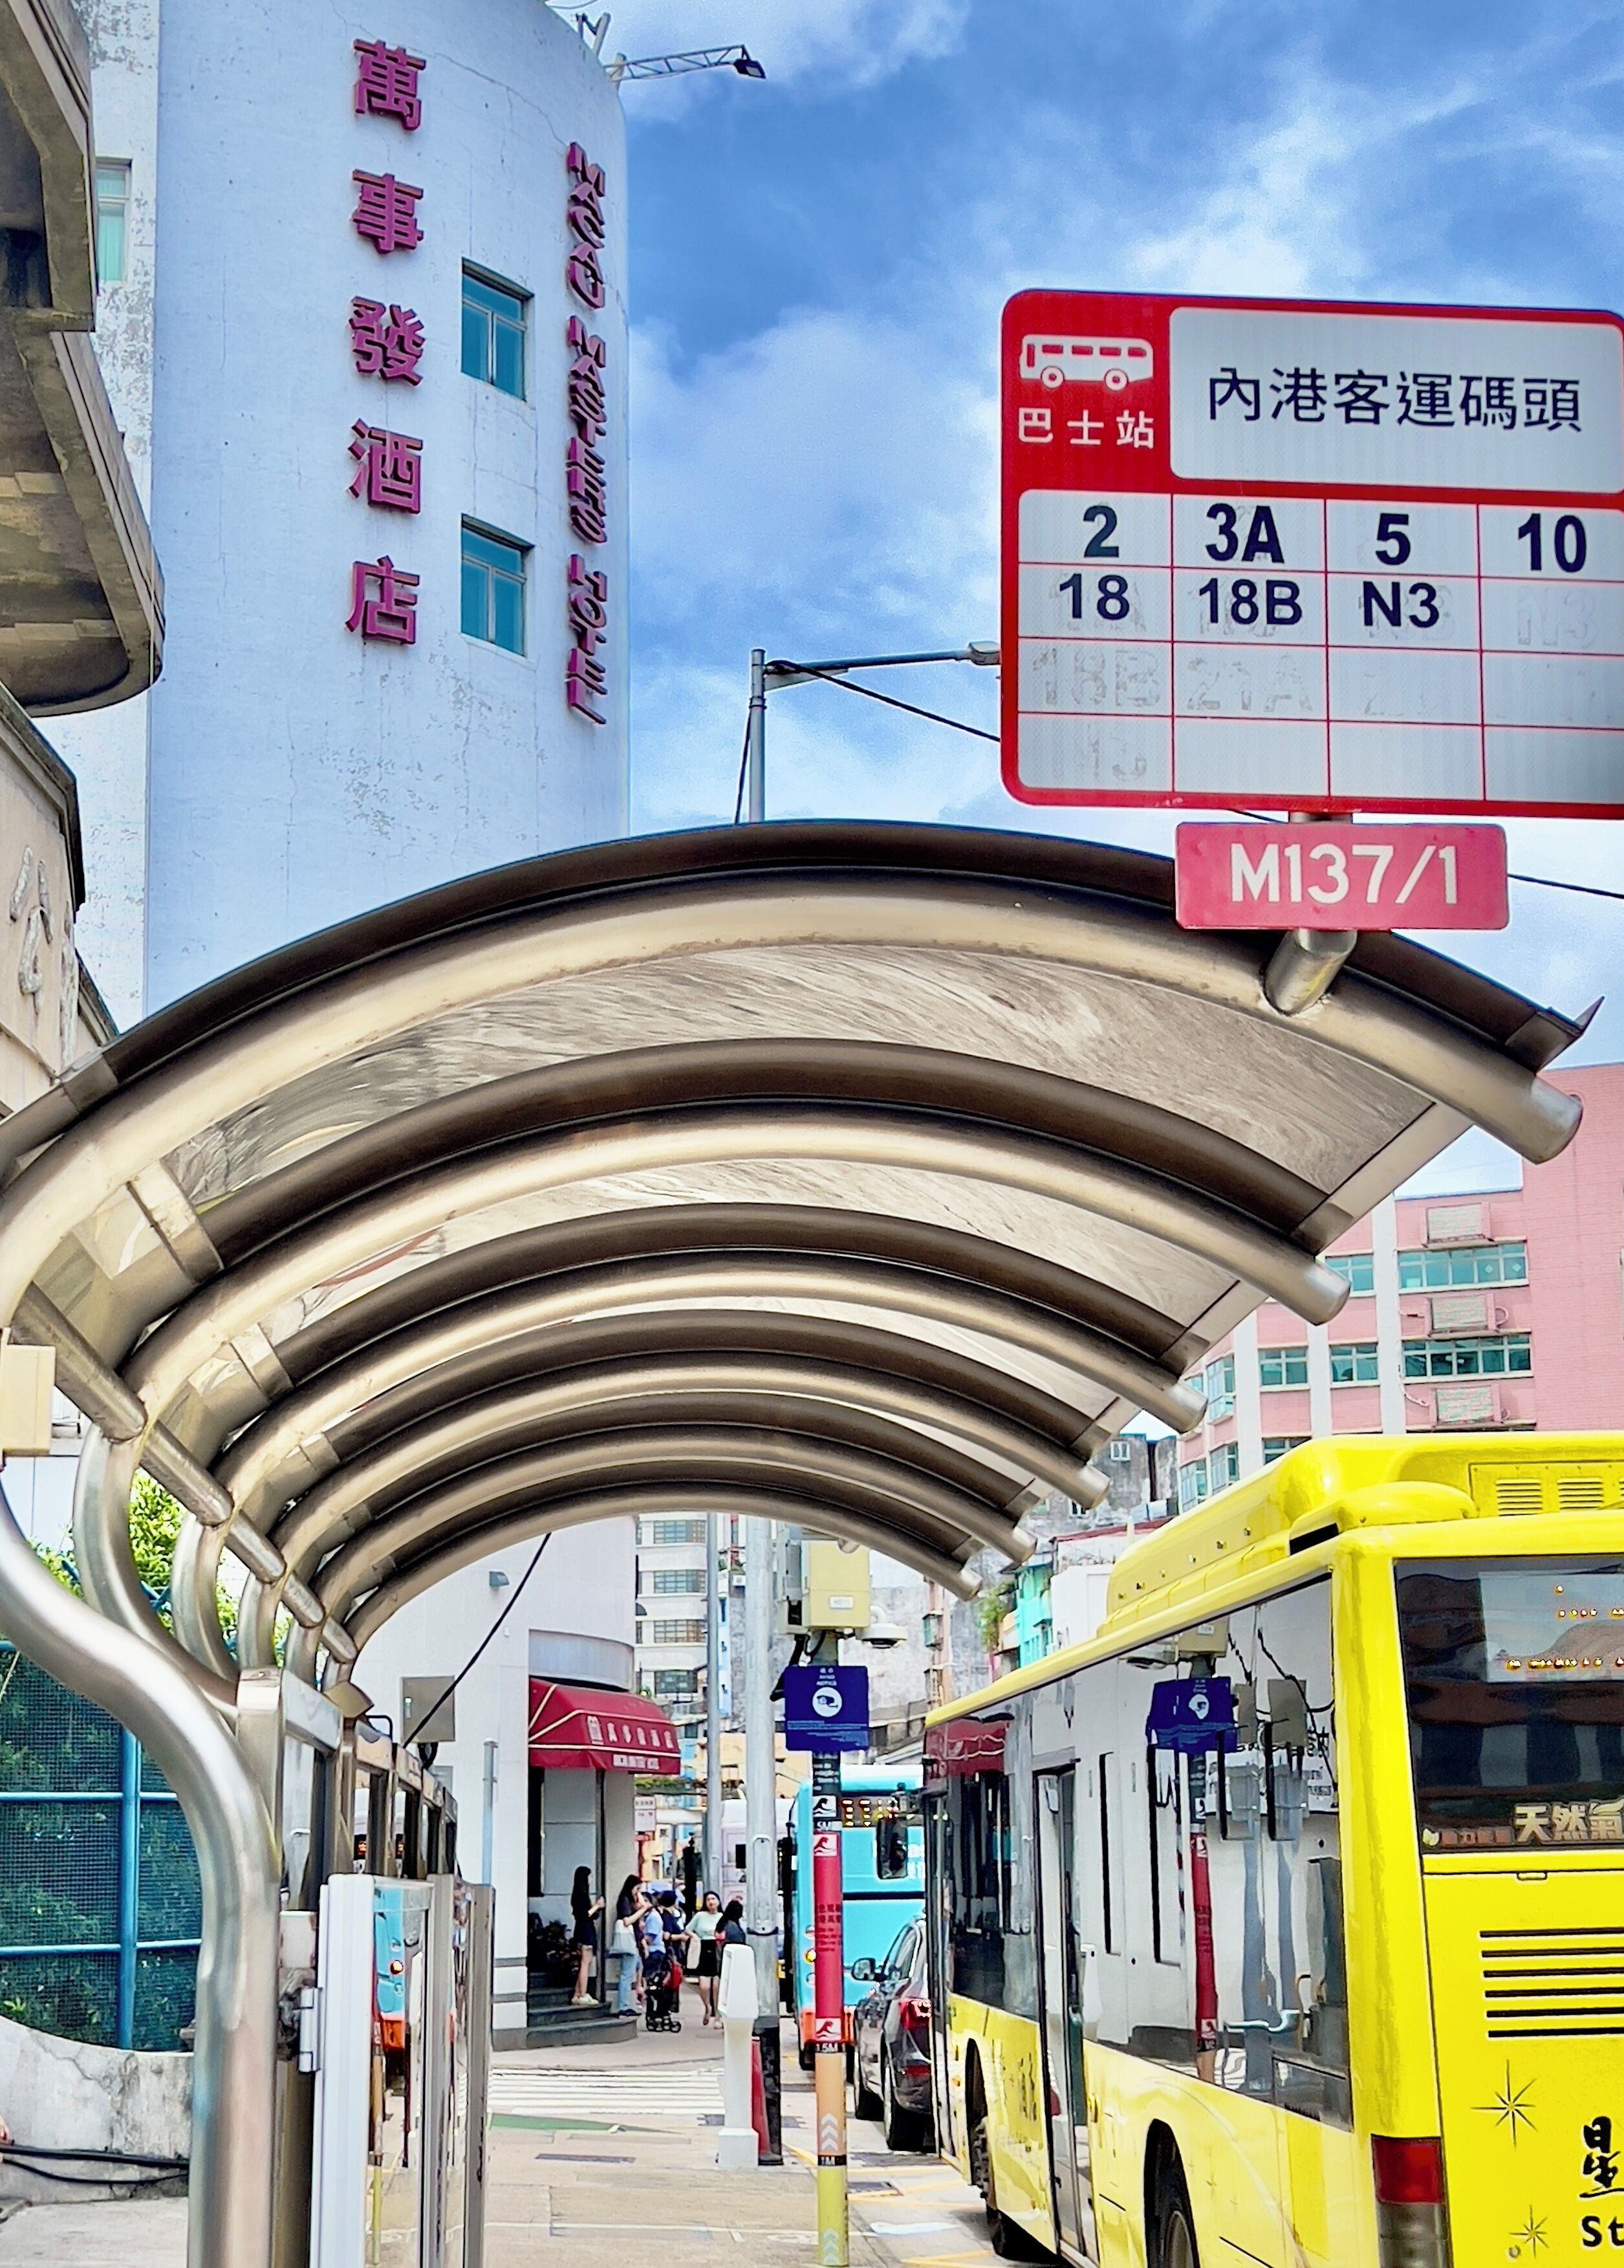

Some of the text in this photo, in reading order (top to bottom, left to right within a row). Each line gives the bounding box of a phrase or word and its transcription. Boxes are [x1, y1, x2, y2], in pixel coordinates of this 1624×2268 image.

[567, 142, 605, 309] MACAU
[346, 39, 425, 646] 萬事發酒店
[1018, 407, 1154, 449] 巴士站
[1209, 367, 1581, 432] 內港客運碼頭
[1083, 503, 1588, 572] 2 3A 5 10
[1059, 573, 1440, 628] 18 18B N3
[566, 554, 607, 725] HOTEL
[1229, 842, 1458, 906] M137/1
[1515, 1798, 1624, 1842] 天然氣
[1581, 2216, 1624, 2247] St
